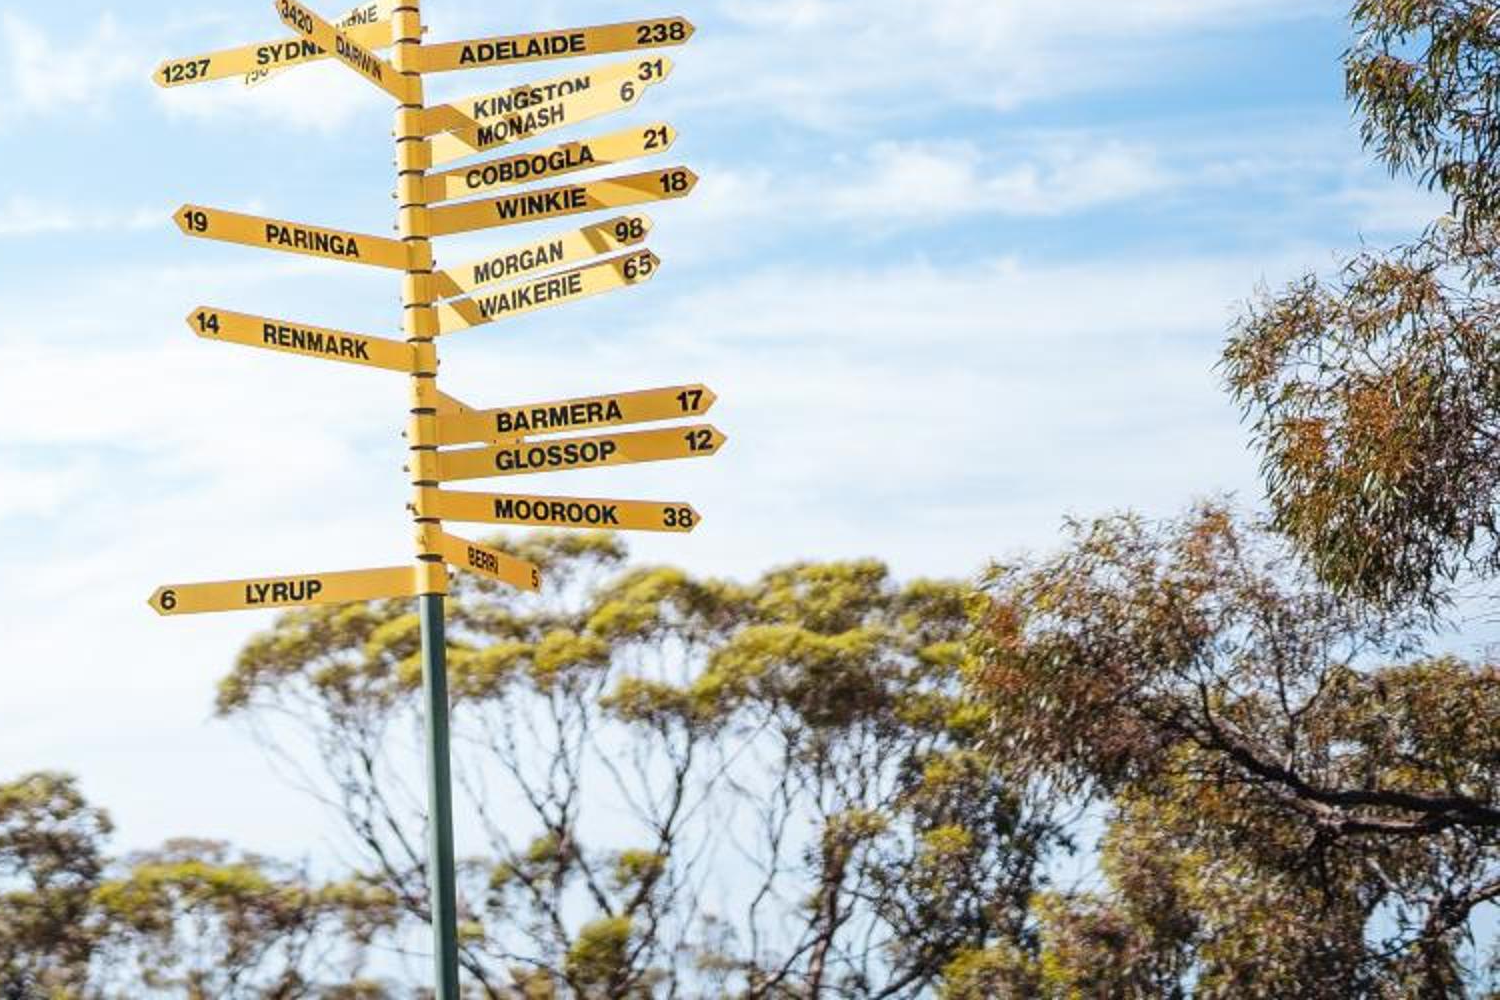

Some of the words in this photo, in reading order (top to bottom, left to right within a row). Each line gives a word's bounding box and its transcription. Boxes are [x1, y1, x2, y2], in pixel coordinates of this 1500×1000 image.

[281, 0, 313, 35] 3420
[336, 34, 383, 82] DARWIN
[459, 34, 586, 65] ADELAIDE
[637, 22, 685, 45] 238
[163, 59, 211, 83] 1237
[638, 59, 663, 81] 31
[477, 103, 565, 146] MONASH
[620, 81, 635, 102] 6
[466, 146, 594, 188] COBDOGLA
[643, 126, 668, 149] 21
[496, 188, 586, 219] WINKIE
[660, 171, 688, 193] 18
[184, 211, 208, 232] 19
[266, 224, 359, 257] PARINGA
[474, 240, 564, 284] MORGAN
[615, 217, 644, 242] 98
[479, 273, 583, 318] WAIKERIE
[623, 255, 653, 279] 65
[197, 311, 220, 333] 14
[263, 323, 370, 360] RENMARK
[496, 400, 622, 433] BARMERA
[677, 390, 703, 411] 17
[495, 441, 616, 470] GLOSSOP
[685, 429, 714, 450] 12
[494, 499, 619, 524] MOOROOK
[663, 508, 693, 527] 38
[467, 546, 499, 575] BERRI
[531, 569, 539, 588] 5
[160, 590, 177, 610] 6
[245, 580, 322, 604] LYRUP
